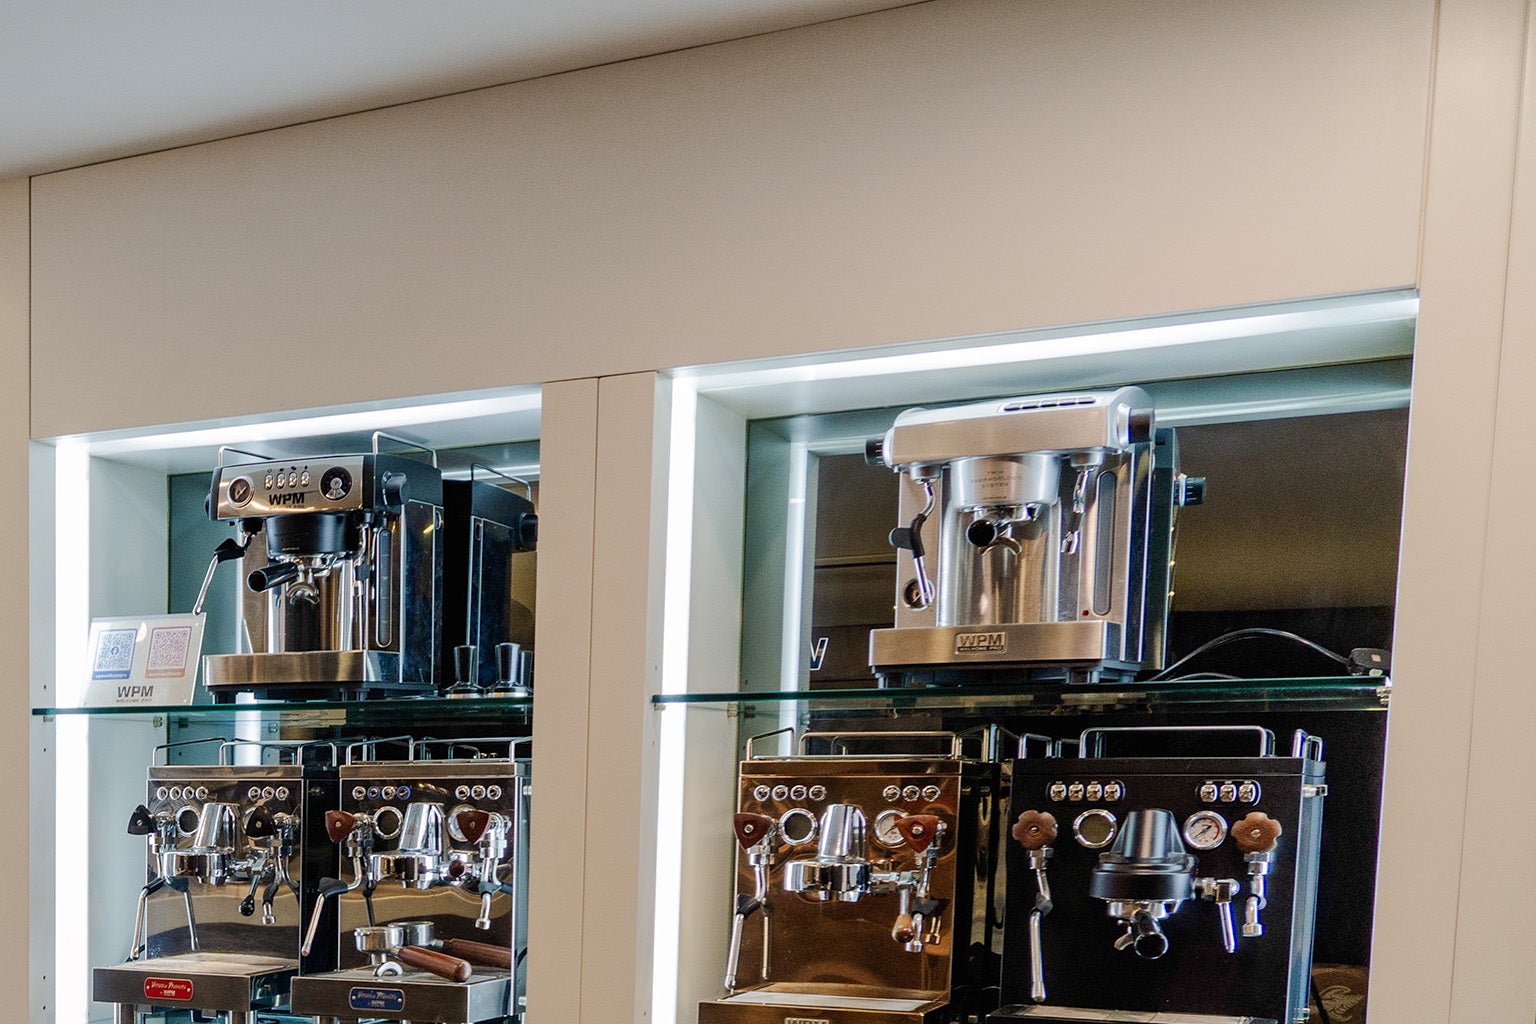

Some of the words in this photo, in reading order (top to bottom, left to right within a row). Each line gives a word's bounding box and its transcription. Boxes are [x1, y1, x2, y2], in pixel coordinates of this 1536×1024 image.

[269, 492, 304, 505] WPM
[959, 634, 1002, 646] WPM
[117, 685, 154, 698] WPM
